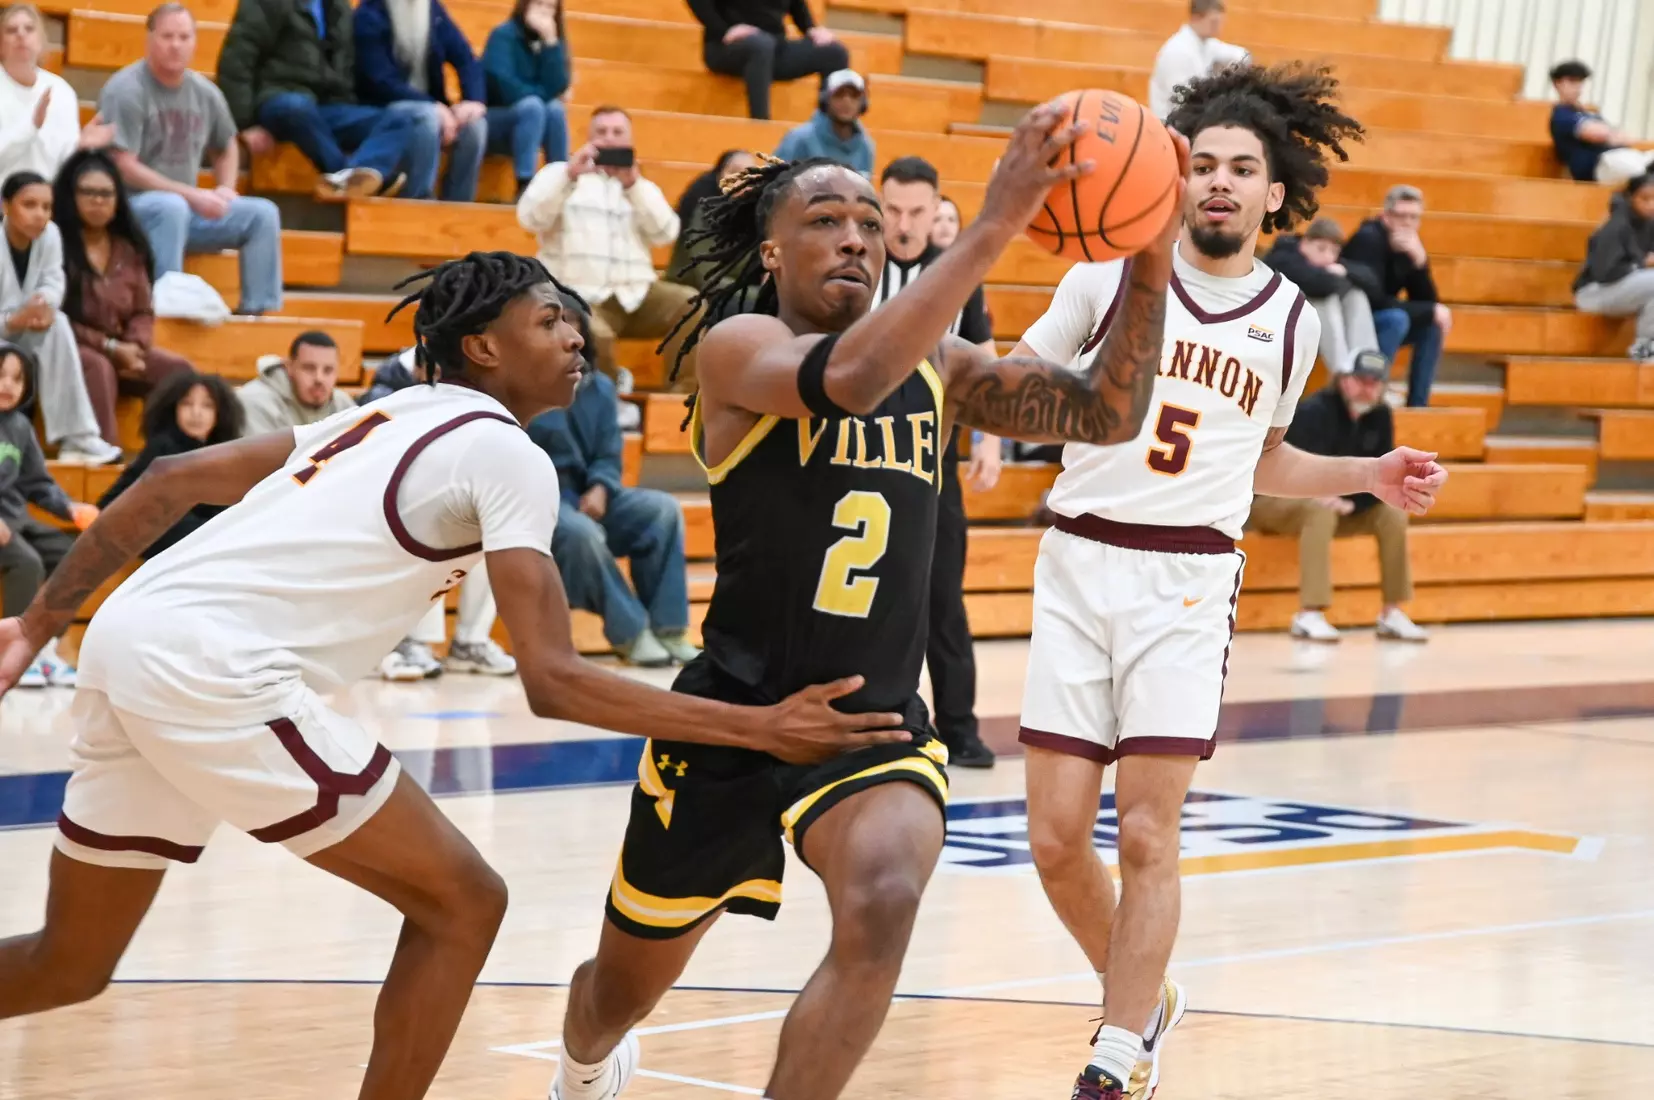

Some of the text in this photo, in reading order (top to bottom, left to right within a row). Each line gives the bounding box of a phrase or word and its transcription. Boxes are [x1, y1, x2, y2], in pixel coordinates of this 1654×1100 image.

[1247, 327, 1275, 340] PSAC
[797, 411, 934, 485] VILLE
[1145, 400, 1202, 478] 5
[812, 490, 892, 618] 2
